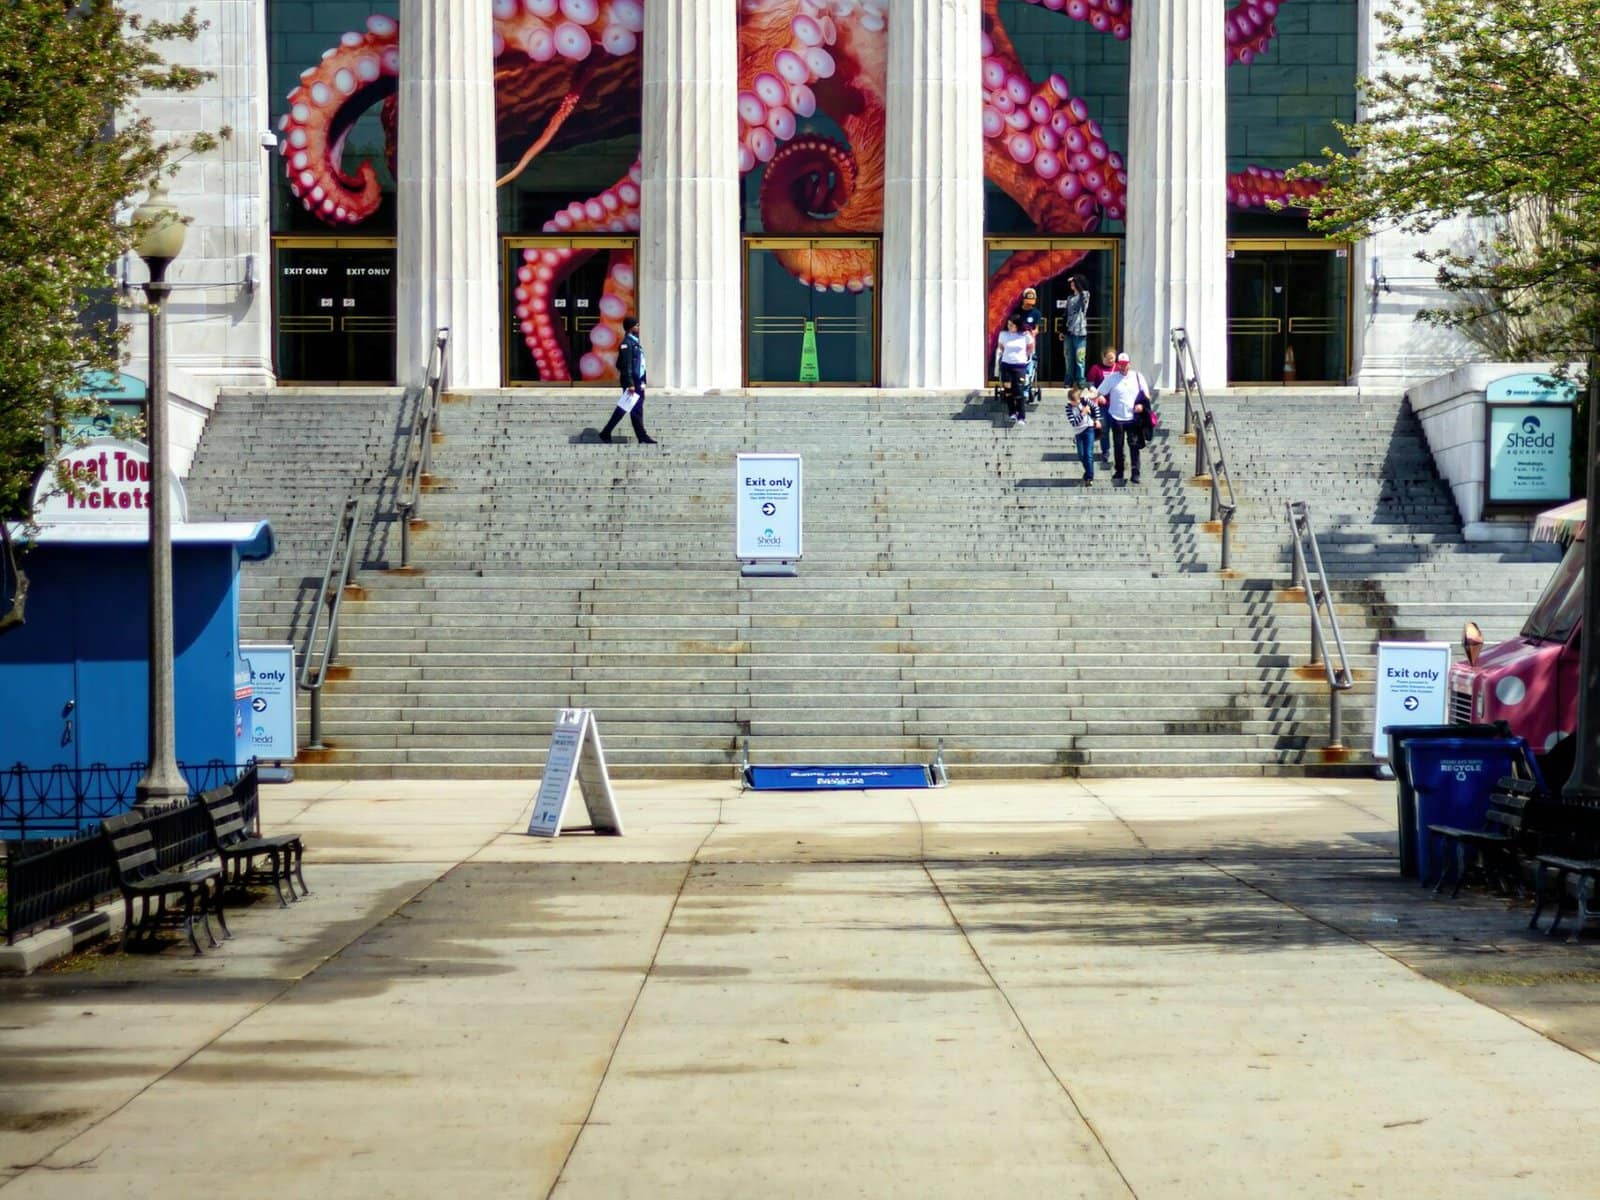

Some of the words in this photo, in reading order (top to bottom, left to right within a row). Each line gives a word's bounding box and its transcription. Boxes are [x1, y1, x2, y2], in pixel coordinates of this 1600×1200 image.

[283, 267, 304, 275] EXIT
[305, 267, 329, 275] ONLY
[346, 268, 366, 276] EXIT
[367, 268, 391, 276] ONLY
[1506, 433, 1555, 448] Shedd
[113, 451, 150, 482] Tou
[745, 477, 766, 487] Exit
[769, 477, 793, 489] only
[259, 670, 286, 682] only
[1387, 667, 1410, 678] Exit
[1413, 669, 1439, 681] only
